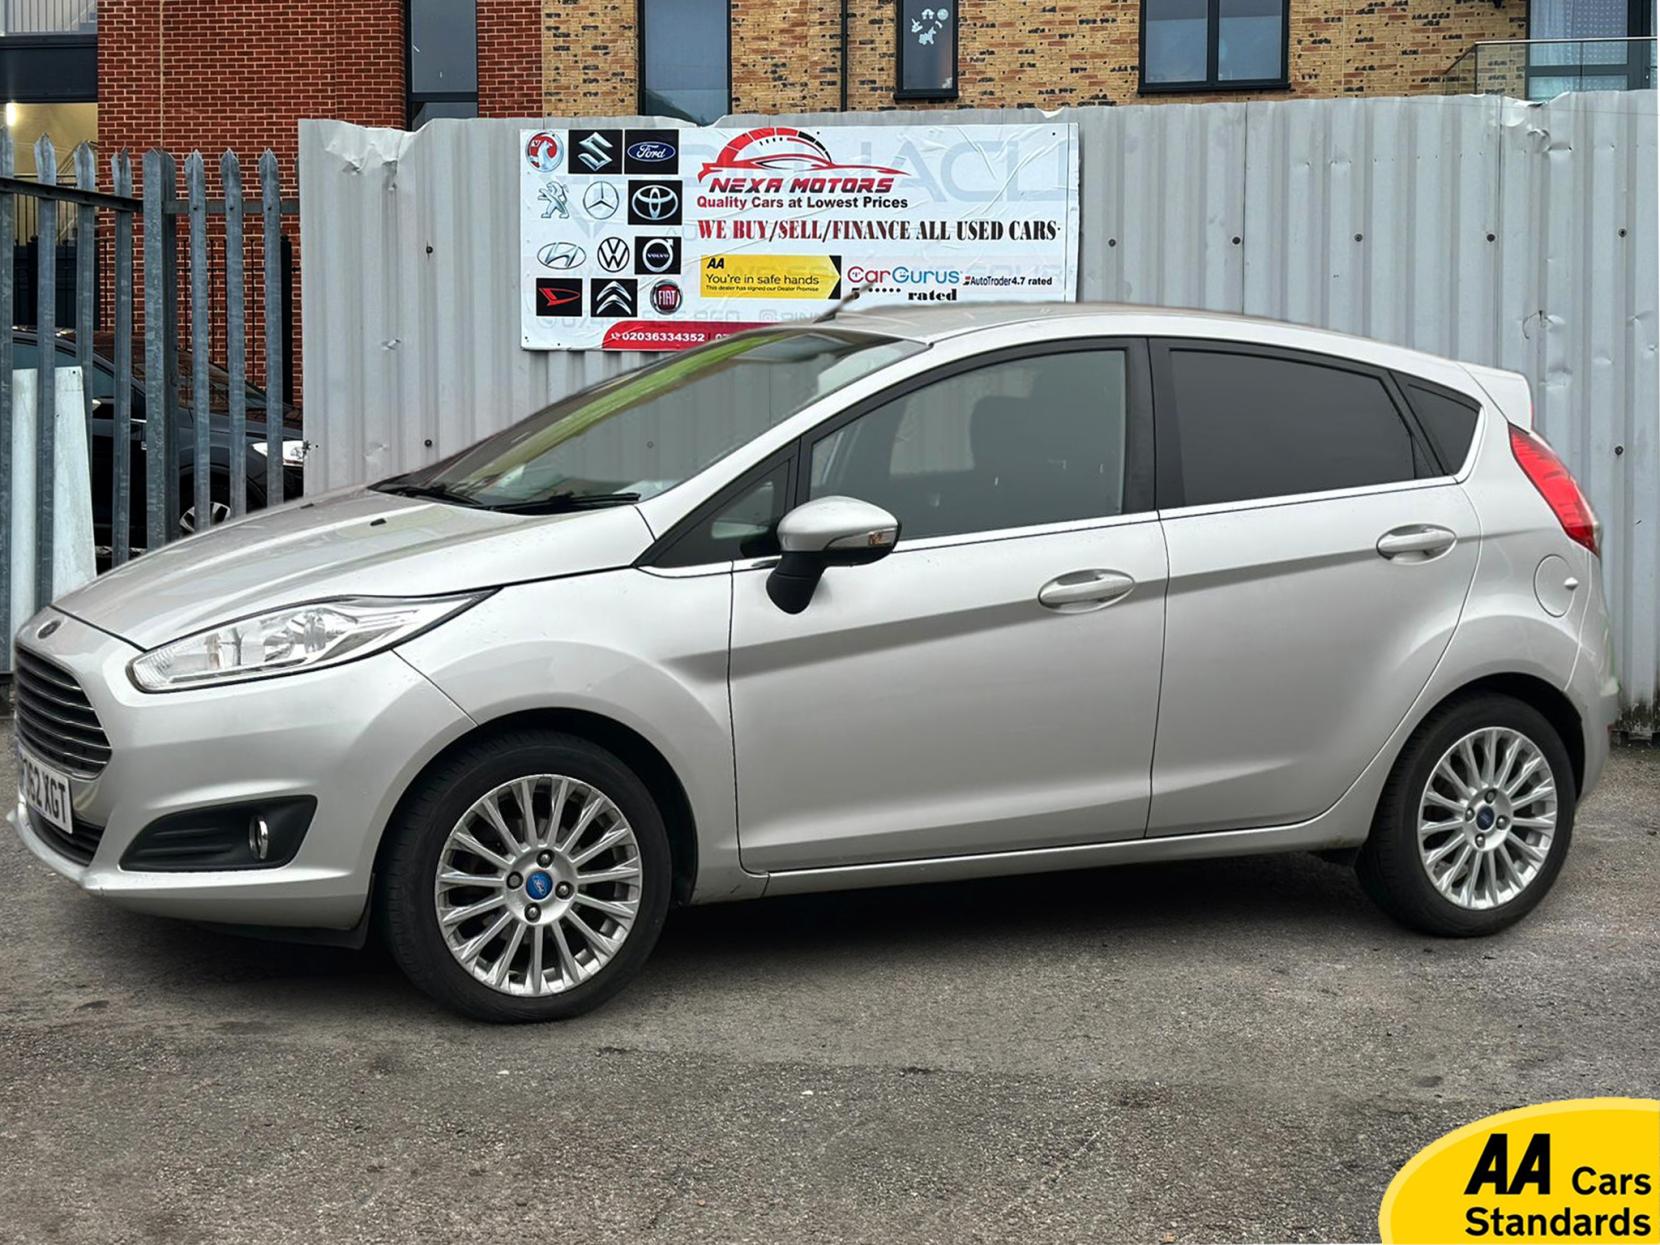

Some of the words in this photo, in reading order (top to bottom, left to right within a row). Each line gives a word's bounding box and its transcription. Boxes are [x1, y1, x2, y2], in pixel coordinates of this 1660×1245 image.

[636, 143, 667, 158] Ford
[709, 178, 783, 193] NEXA
[789, 178, 895, 193] MOTORS
[697, 196, 747, 210] Quality
[752, 196, 784, 208] Cars
[788, 196, 803, 208] at
[807, 196, 859, 208] Lowest
[863, 196, 908, 209] Prices
[697, 220, 727, 240] WE
[916, 220, 950, 240] ALL
[956, 220, 1004, 240] USED
[1009, 220, 1057, 240] CARS
[706, 257, 725, 269] AA
[706, 274, 741, 284] You're
[744, 274, 754, 284] in
[757, 274, 781, 285] safe
[784, 275, 820, 285] hands
[847, 266, 960, 284] CarGurus
[1028, 277, 1053, 286] rated
[658, 290, 676, 305] FIAT
[908, 288, 957, 301] rated
[622, 333, 705, 342] 02036334352
